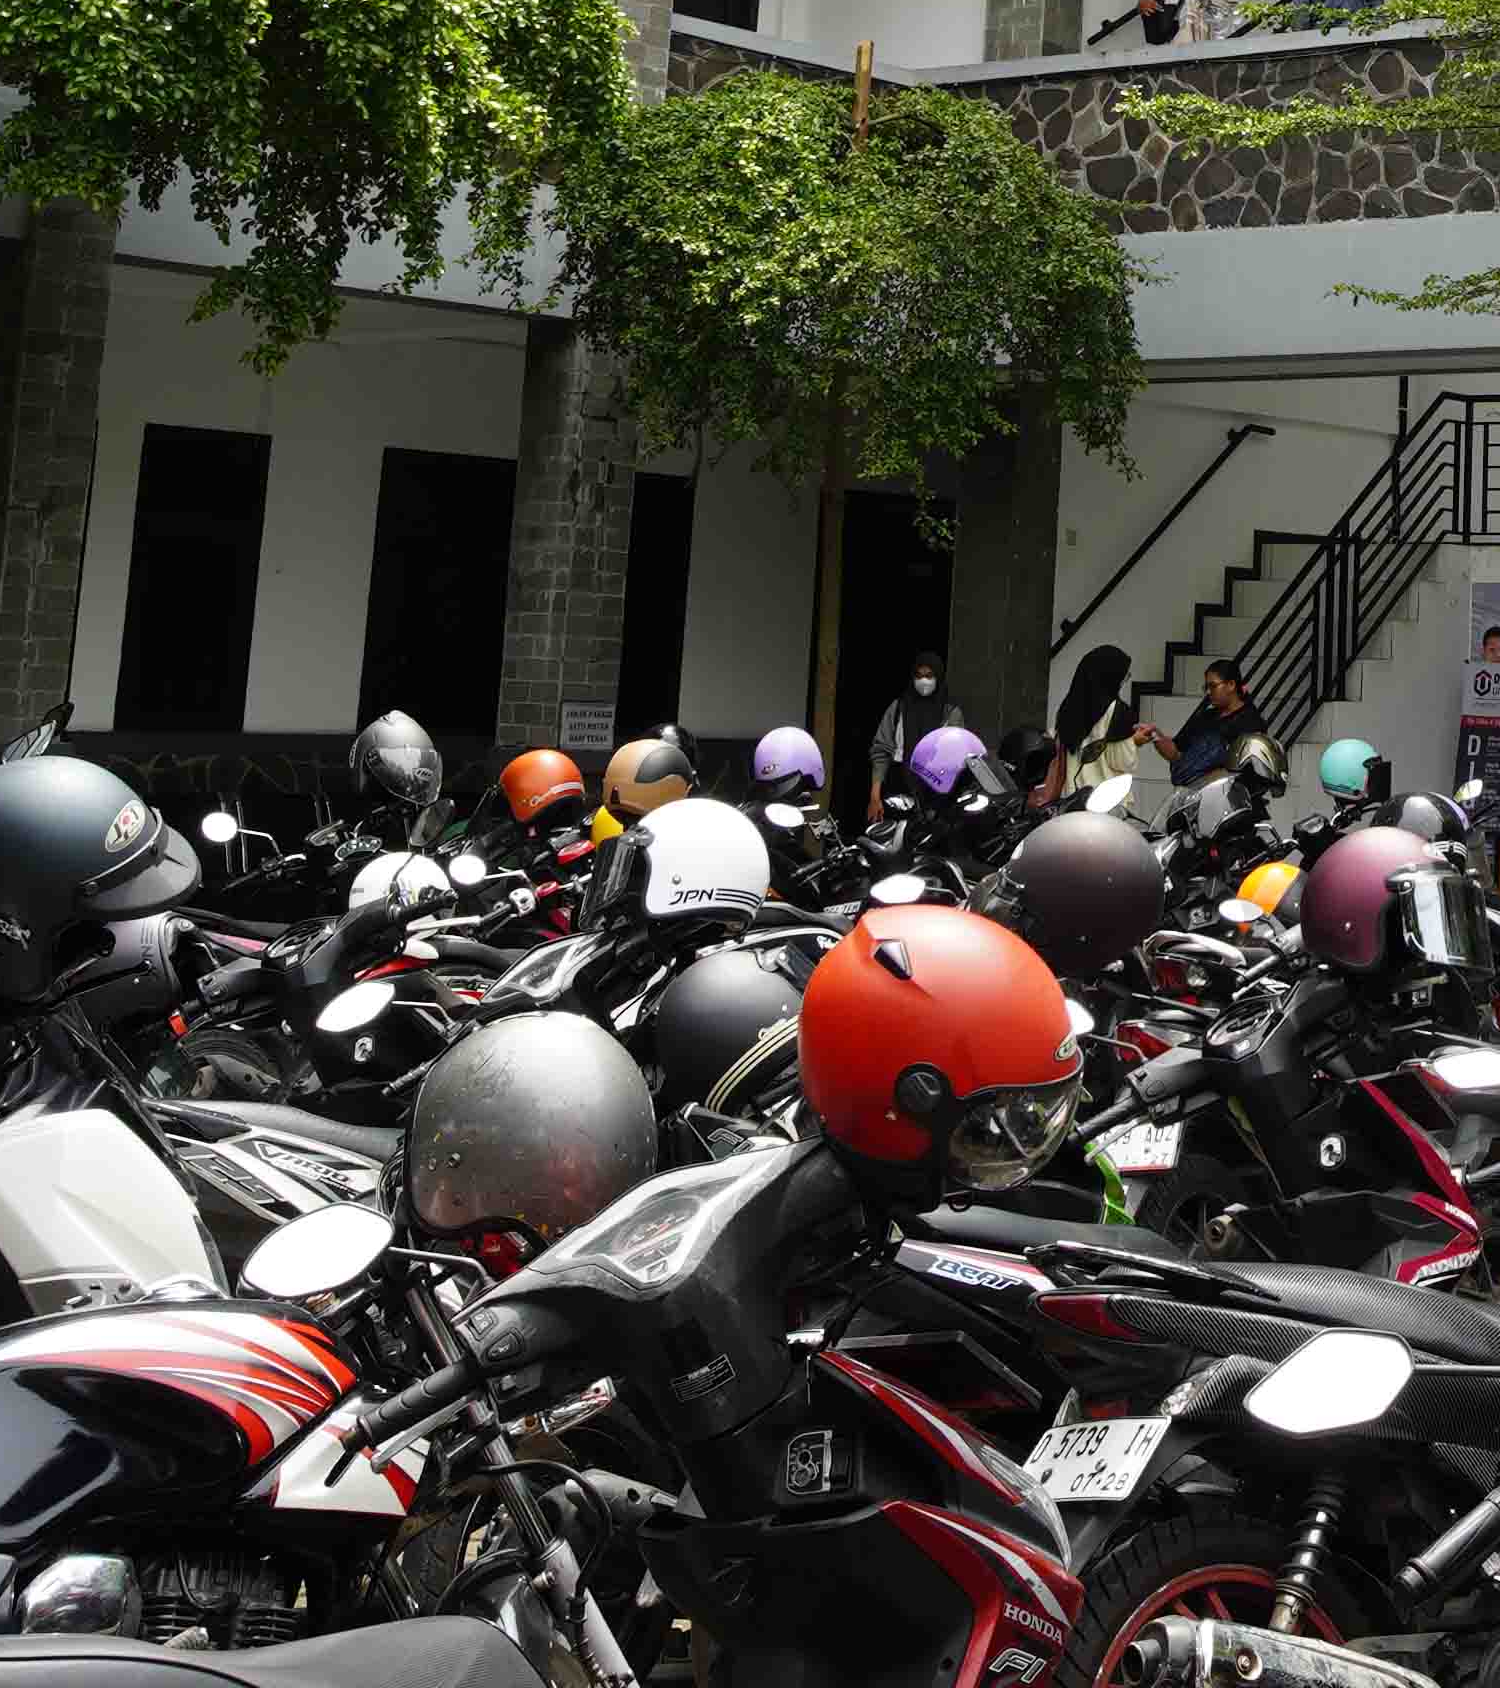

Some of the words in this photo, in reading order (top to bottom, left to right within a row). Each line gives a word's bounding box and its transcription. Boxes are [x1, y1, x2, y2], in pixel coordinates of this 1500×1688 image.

[1467, 734, 1481, 756] D
[668, 888, 715, 906] JPN
[1030, 1433, 1053, 1464] D
[1053, 1424, 1110, 1460] 5739
[1003, 1600, 1063, 1647] HONDA
[988, 1647, 1047, 1684] FI
